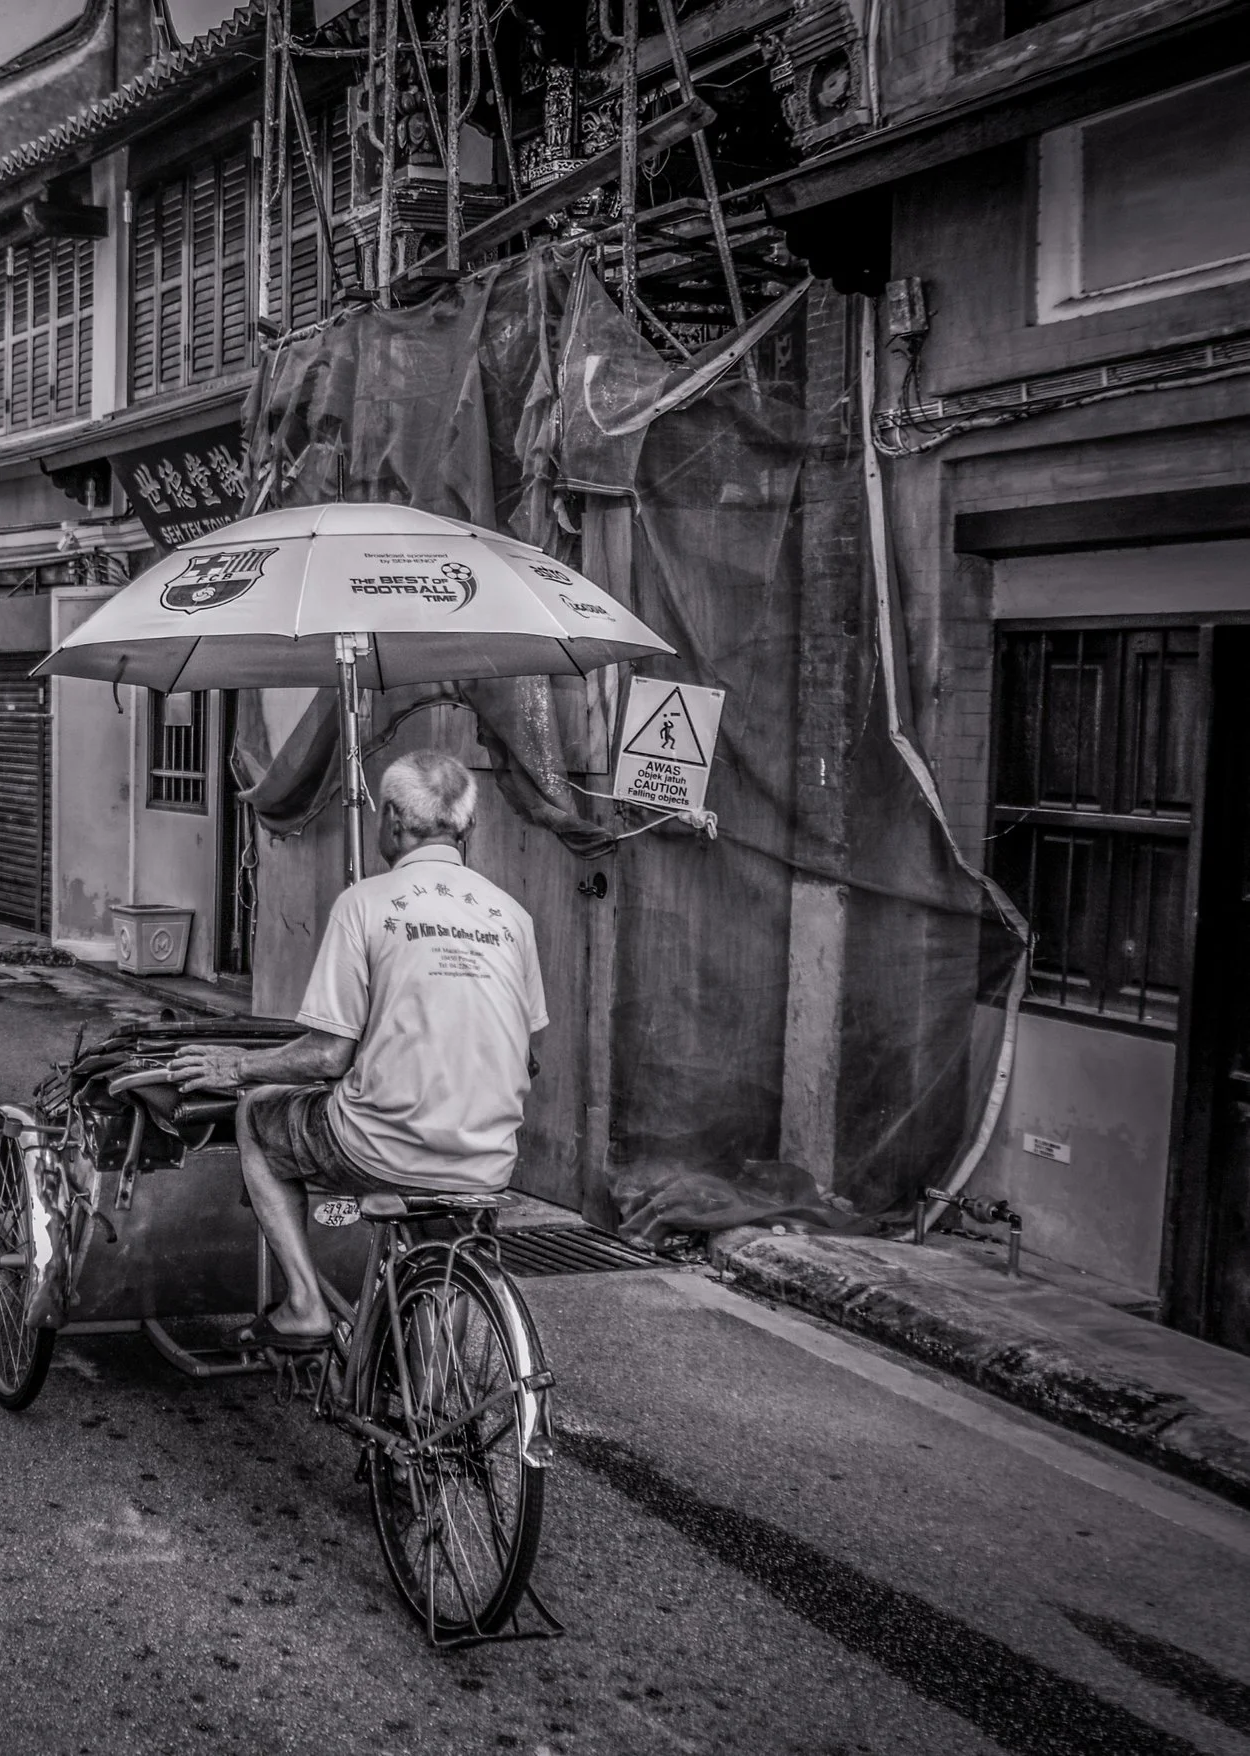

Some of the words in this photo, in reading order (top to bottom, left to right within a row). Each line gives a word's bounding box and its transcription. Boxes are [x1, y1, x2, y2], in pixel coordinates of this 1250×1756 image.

[161, 523, 186, 544] SEH
[181, 520, 206, 541] TEK
[379, 576, 429, 585] BEST
[351, 585, 456, 595] FOOTBALL
[646, 761, 681, 776] AWAS
[638, 770, 662, 781] Objek
[664, 773, 687, 785] jatuh
[634, 778, 688, 797] CAUTION
[628, 787, 656, 801] Falling
[658, 794, 690, 806] objects
[405, 922, 419, 941] Sin
[419, 923, 436, 938] Kim
[436, 924, 450, 937] San
[451, 926, 474, 941] Coffee
[475, 929, 500, 947] Centre
